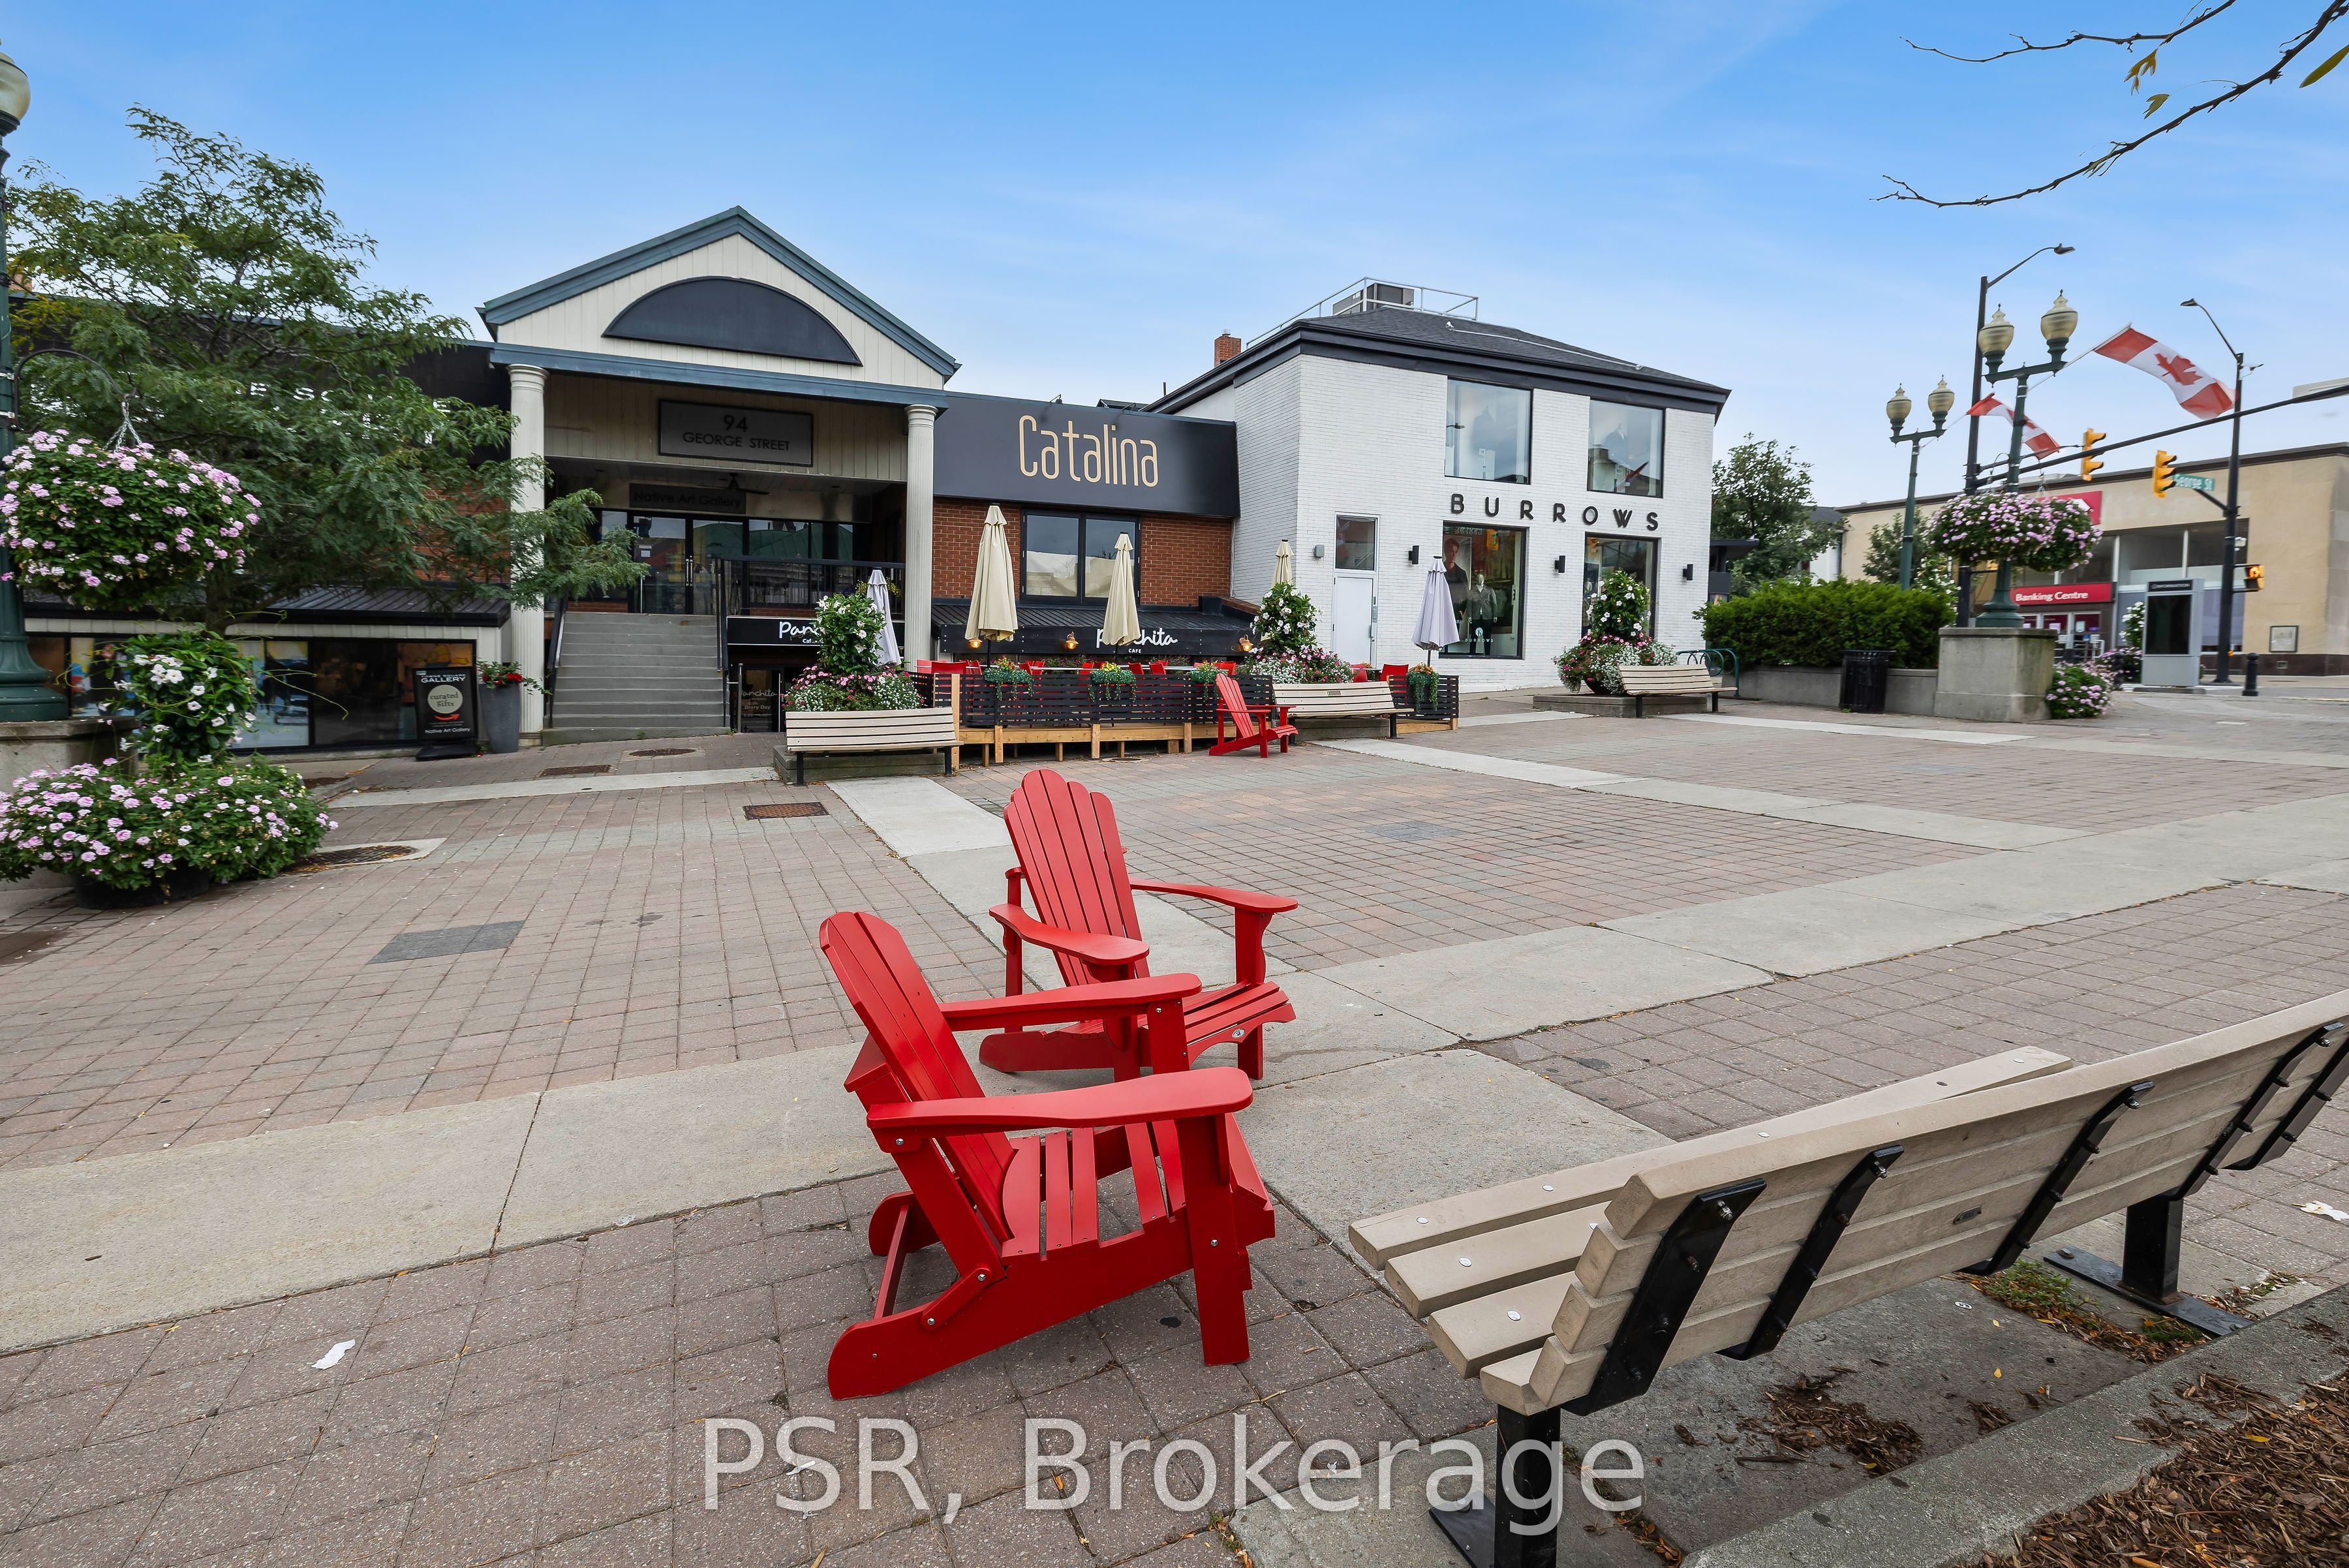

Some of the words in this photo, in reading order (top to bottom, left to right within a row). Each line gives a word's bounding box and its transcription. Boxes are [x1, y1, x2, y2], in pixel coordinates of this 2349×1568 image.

[723, 414, 748, 433] 94
[683, 431, 743, 447] GEORGE
[749, 438, 791, 451] STREET
[1019, 415, 1159, 487] Catalina
[634, 490, 674, 503] Native
[679, 493, 695, 504] Art
[698, 495, 741, 509] Gallery
[1451, 493, 1659, 531] BURROWS
[2015, 593, 2053, 602] Banking
[2055, 591, 2089, 600] Centre
